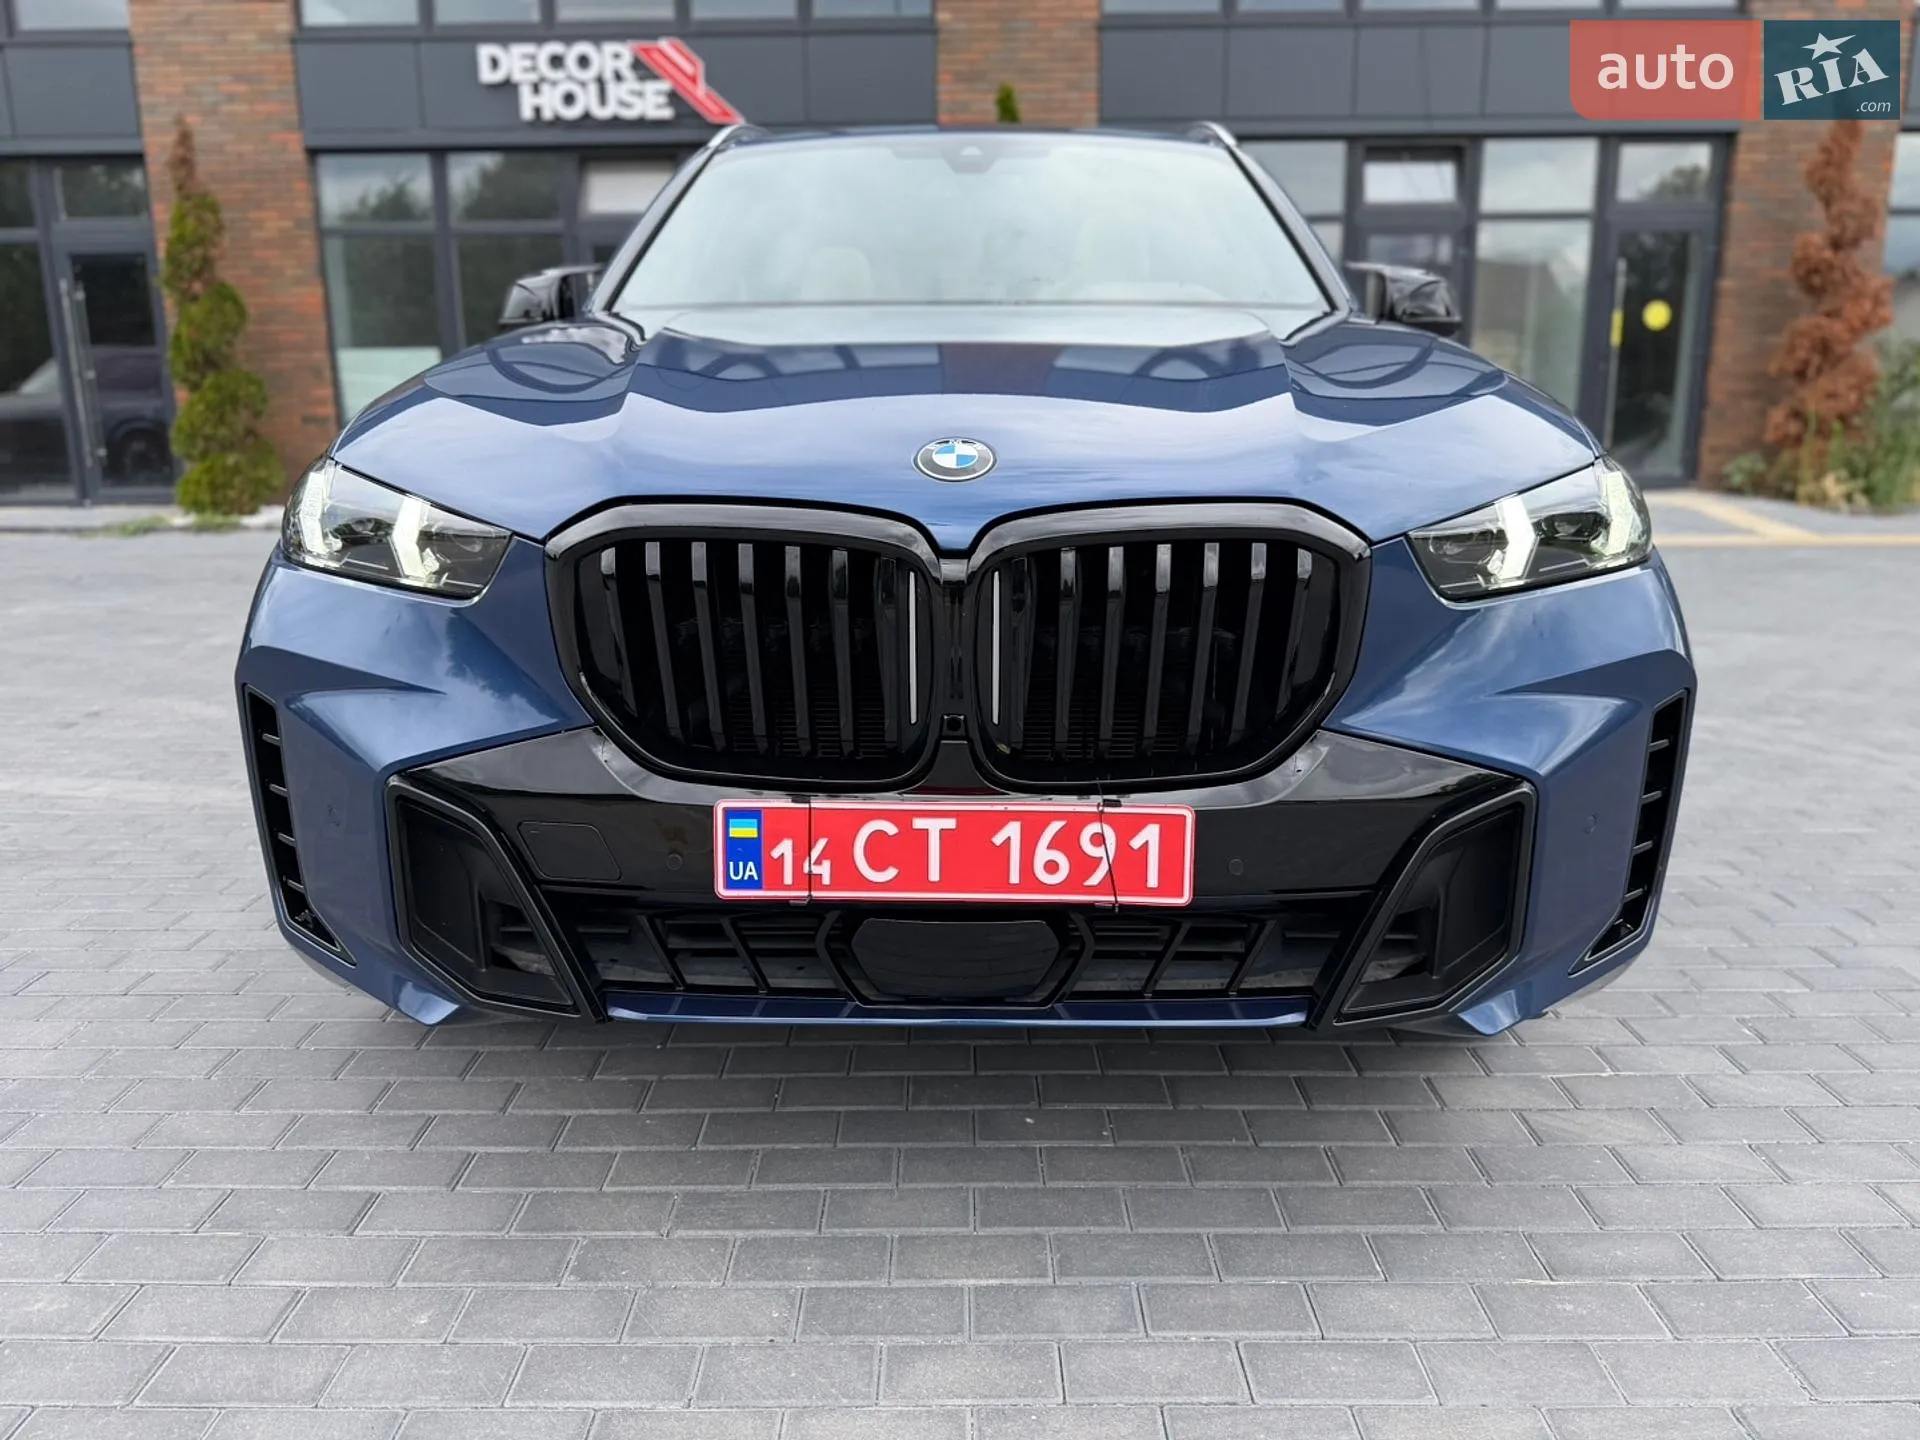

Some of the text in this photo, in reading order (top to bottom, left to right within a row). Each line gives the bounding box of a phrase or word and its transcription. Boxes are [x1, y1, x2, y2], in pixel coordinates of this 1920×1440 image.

[477, 41, 637, 84] DECOR
[518, 80, 675, 121] HOUSE
[729, 861, 758, 880] UA
[770, 817, 1160, 888] 14 CT 1691
